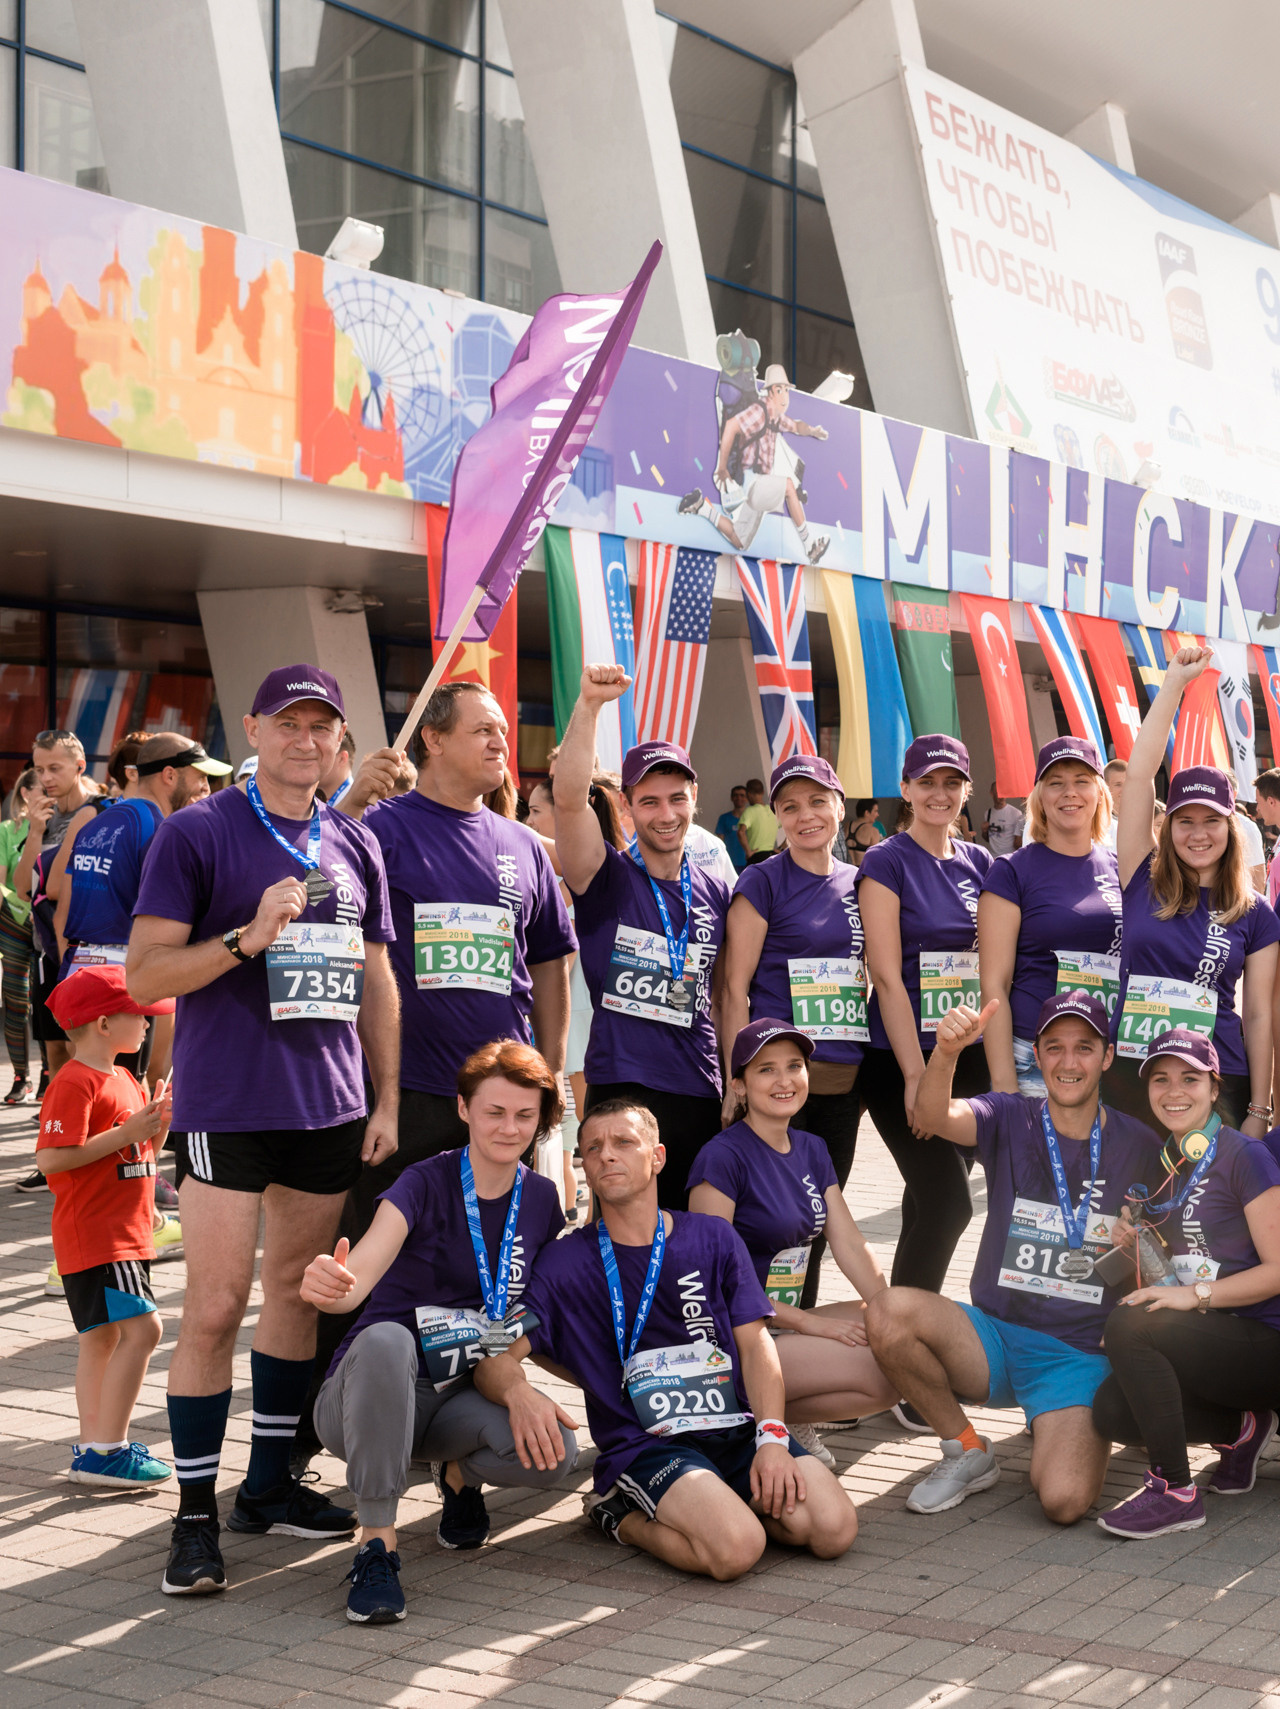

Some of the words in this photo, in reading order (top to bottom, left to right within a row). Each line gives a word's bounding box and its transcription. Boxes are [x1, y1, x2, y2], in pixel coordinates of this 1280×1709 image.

[924, 89, 1071, 210] БЕЖАТЬ,
[936, 158, 1058, 253] ЧТОБЫ
[1159, 239, 1187, 265] IAAF
[950, 226, 1145, 343] ПОБЕЖДАТЬ
[860, 410, 1257, 645] МІНСК
[286, 681, 328, 697] Wellness
[642, 750, 679, 761] Wellness
[926, 749, 959, 761] Wellness
[1051, 748, 1084, 758] Wellness
[782, 765, 815, 777] Wellness
[1182, 783, 1216, 795] Wellness
[448, 931, 470, 939] 2018
[302, 955, 323, 964] 2018
[329, 960, 355, 969] Aleksandr
[420, 945, 511, 976] 13024
[638, 959, 658, 970] 2018
[691, 905, 718, 1012] Wellness
[284, 970, 357, 1001] 7354
[944, 978, 960, 986] 2018
[1083, 975, 1100, 984] 2018
[615, 971, 672, 1004] 664
[796, 998, 867, 1024] 11984
[1056, 1000, 1092, 1014] Wellness
[1148, 1004, 1166, 1012] 2018
[1157, 1039, 1192, 1051] Wellness
[44, 1119, 64, 1135] 勇気
[1013, 1217, 1028, 1225] 10,55
[1040, 1232, 1061, 1243] 2018
[421, 1327, 439, 1335] 10,55
[431, 1331, 456, 1341] МИНСКИЙ
[425, 1336, 457, 1347] ПОЛУМАРАФОН
[660, 1376, 681, 1386] 2018
[649, 1388, 726, 1420] 9220
